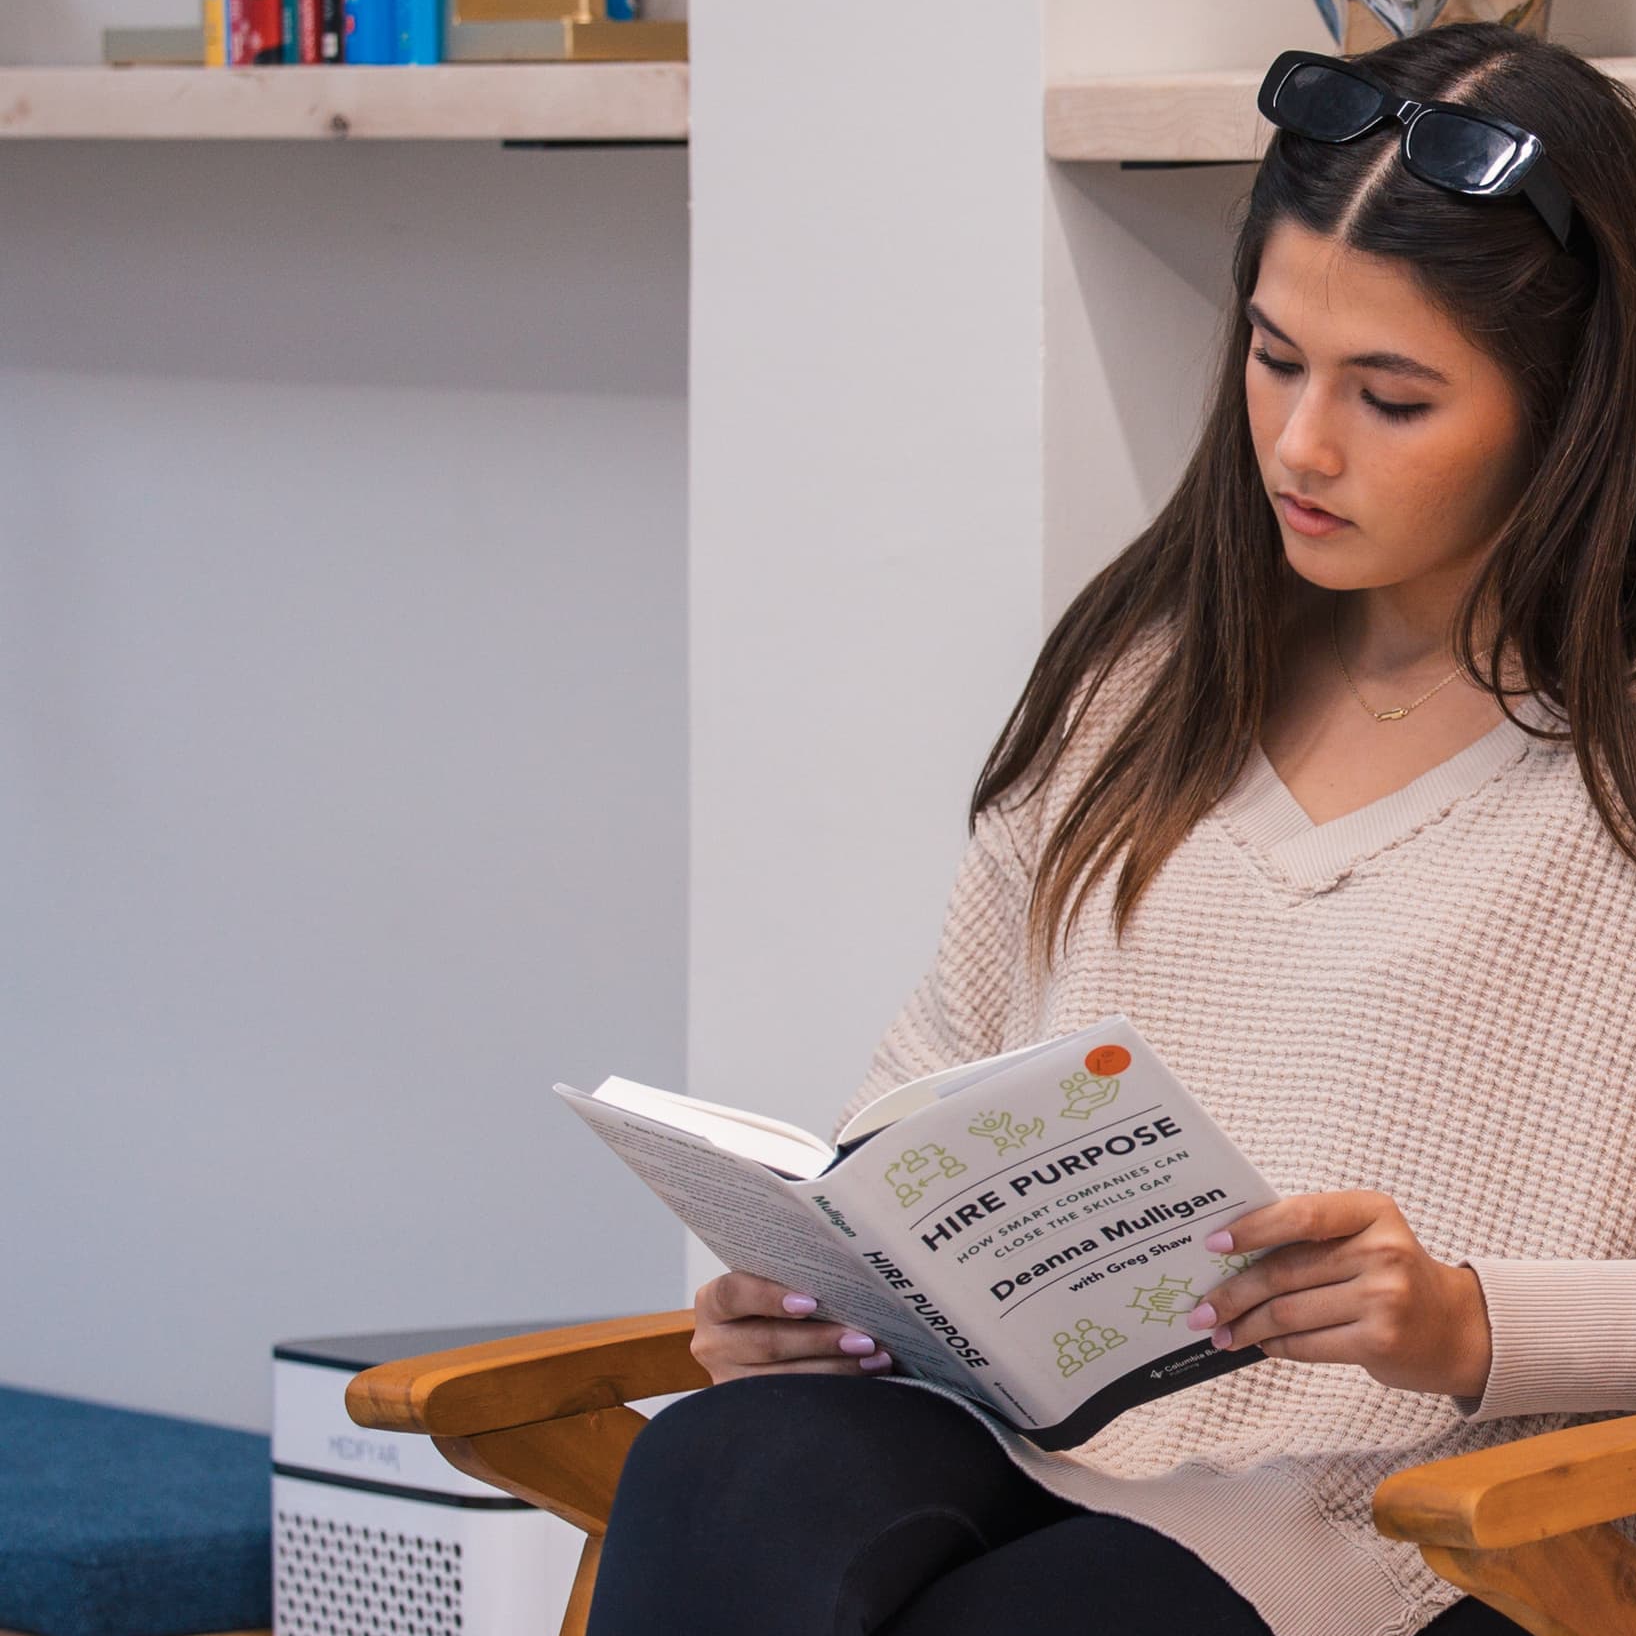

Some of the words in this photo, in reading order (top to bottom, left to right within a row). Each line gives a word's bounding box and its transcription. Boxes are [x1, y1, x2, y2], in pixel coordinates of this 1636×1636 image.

[811, 1194, 857, 1238] Mulligan
[920, 1190, 1007, 1252] HIRE
[1008, 1116, 1183, 1197] PURPOSE
[957, 1235, 994, 1265] HOW
[998, 1205, 1051, 1237] SMART
[1055, 1166, 1150, 1208] COMPANIES
[1154, 1150, 1190, 1169] CAN
[993, 1227, 1044, 1260] CLOSE
[1047, 1211, 1080, 1230] THE
[1083, 1187, 1136, 1216] SKILLS
[1139, 1173, 1174, 1193] GAP
[989, 1235, 1100, 1302] Deanna
[1099, 1186, 1228, 1242] Mulligan
[1068, 1270, 1105, 1294] with
[1106, 1251, 1150, 1275] Greg
[1148, 1234, 1193, 1258] Shaw
[863, 1250, 914, 1290] HIRE
[904, 1293, 991, 1369] PURPOSE
